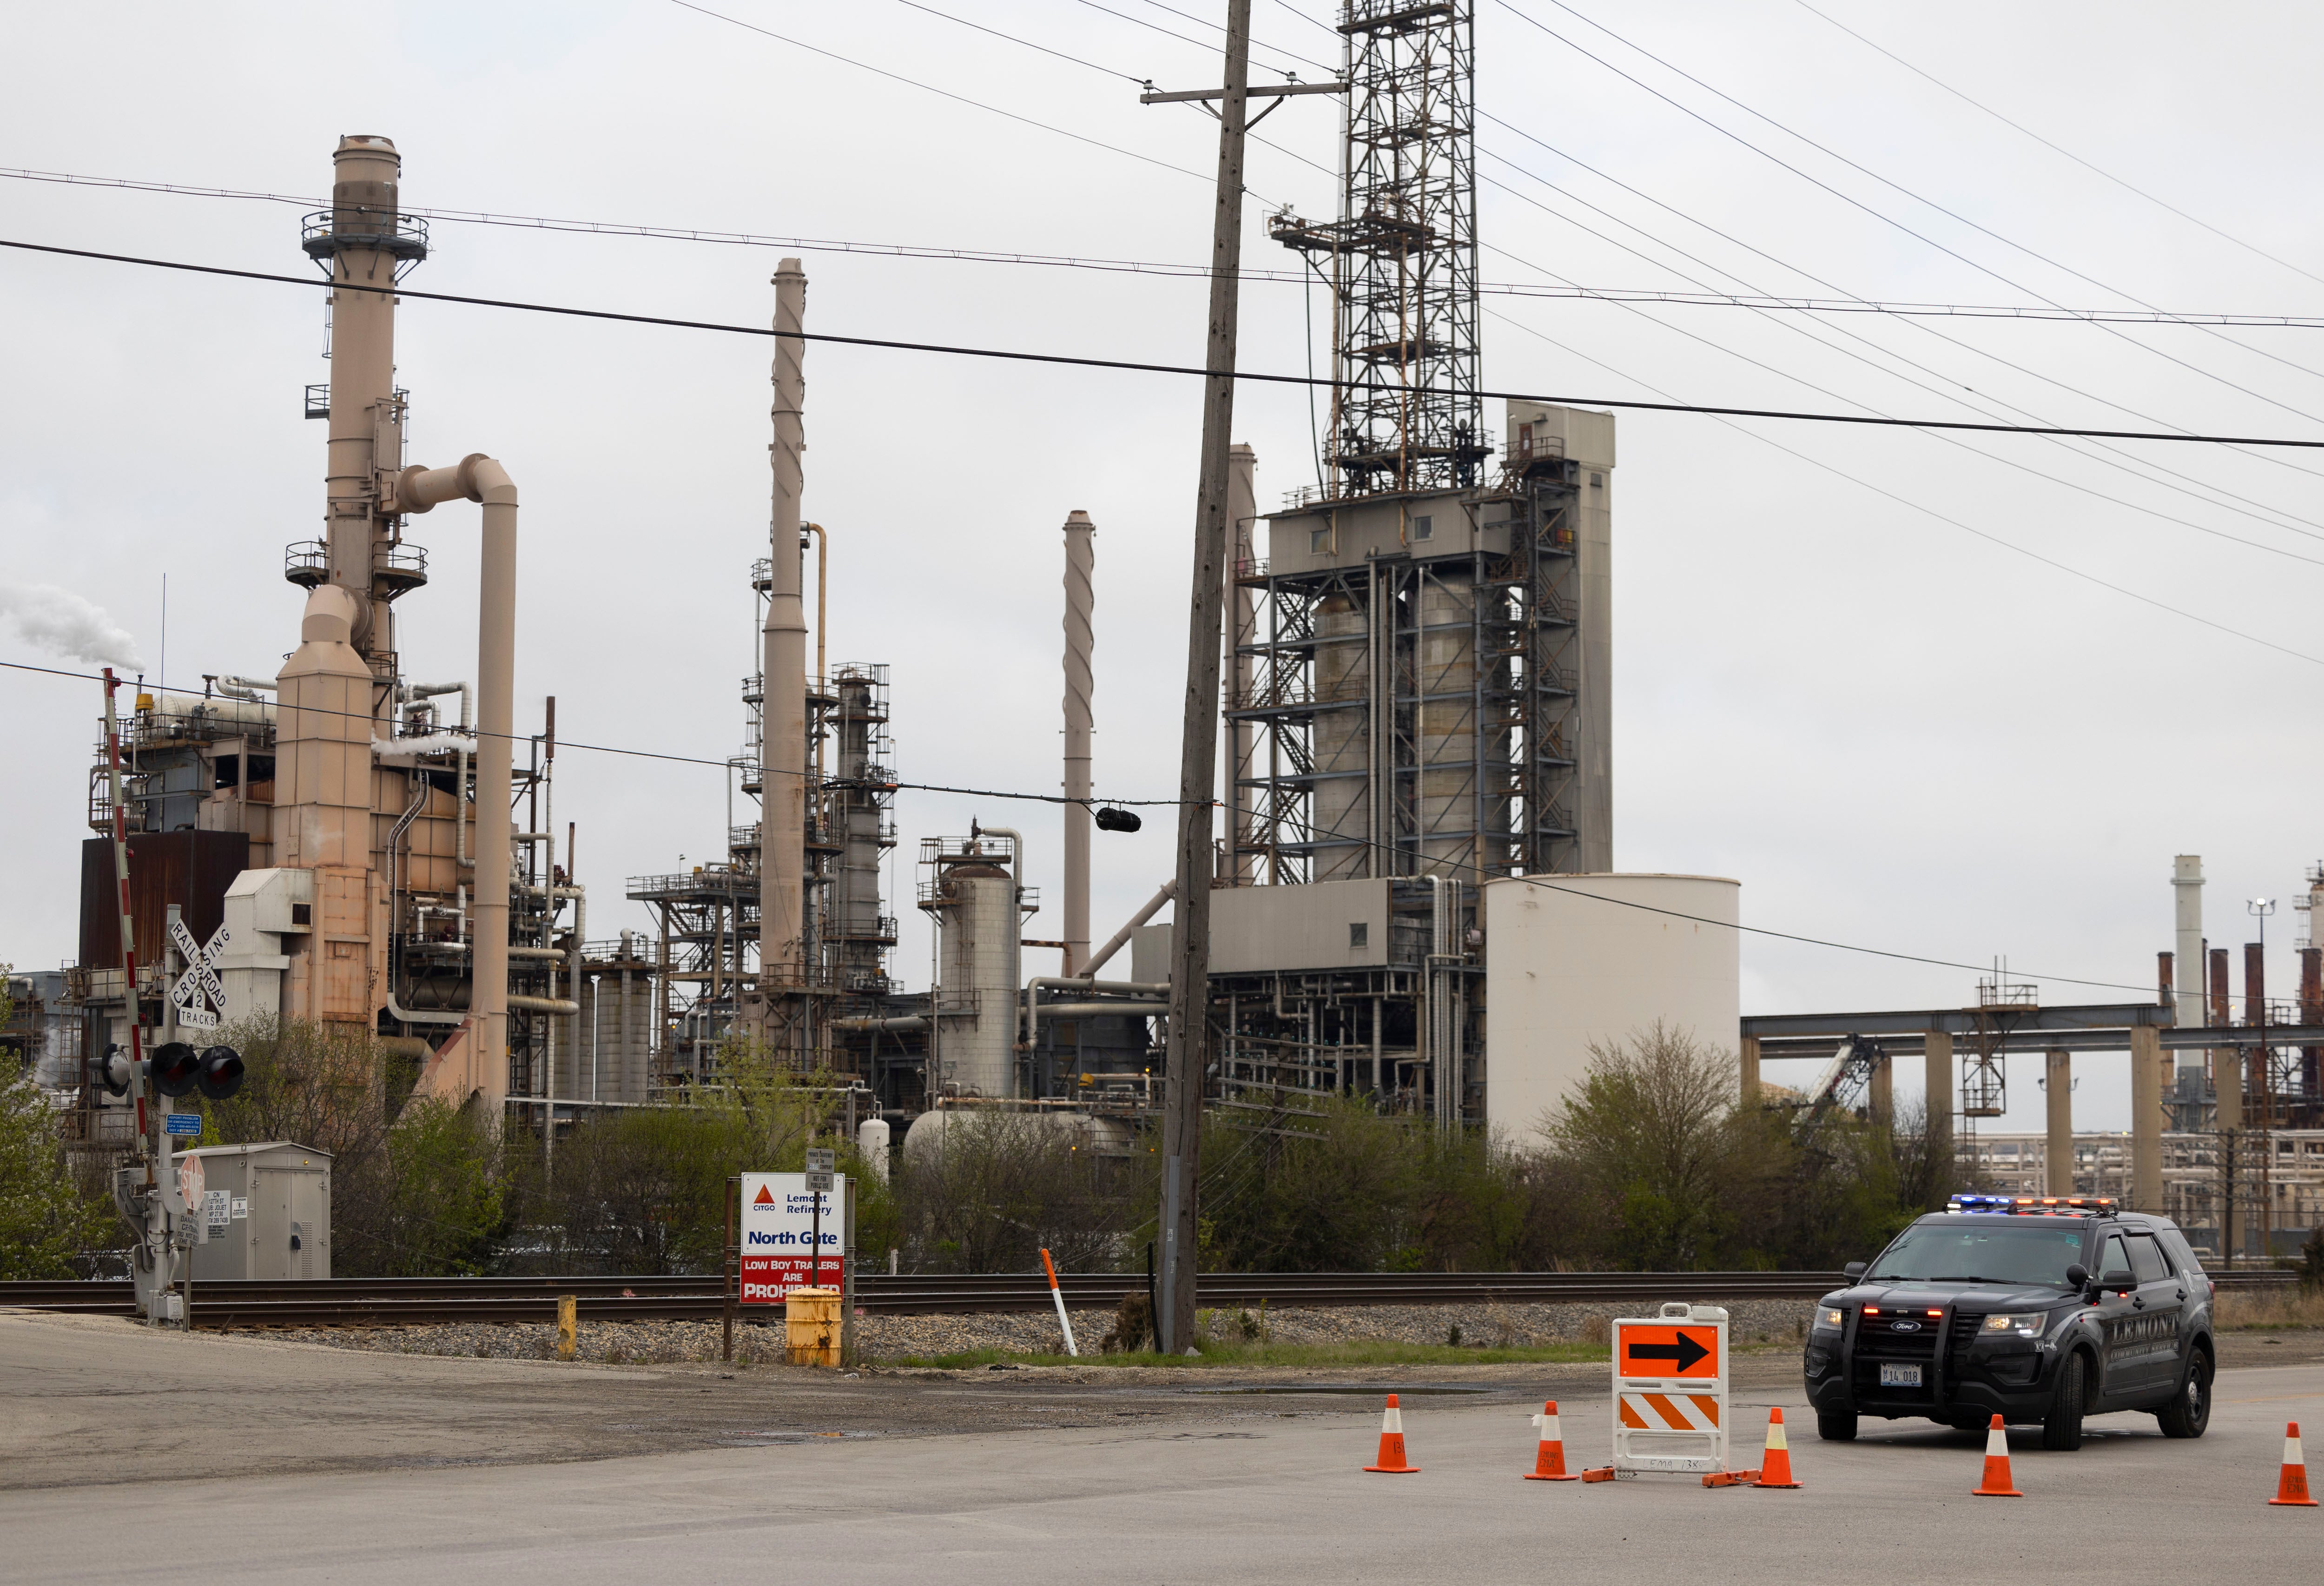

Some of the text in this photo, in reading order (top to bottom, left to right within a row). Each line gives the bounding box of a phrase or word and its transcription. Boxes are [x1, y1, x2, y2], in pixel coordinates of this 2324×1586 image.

[173, 923, 225, 1007] RAIL ROAD
[174, 929, 230, 1004] CROSSING
[196, 994, 202, 1008] 2
[182, 1011, 215, 1026] TRACKS
[183, 1170, 203, 1192] STOP
[748, 1231, 796, 1244] North
[745, 1261, 839, 1270] LOW BOY TRALERS
[782, 1273, 803, 1282] ARE
[2112, 1311, 2179, 1345] LEMONT
[2034, 1339, 2057, 1352] 17-4
[2111, 1343, 2151, 1362] COMMUNITY
[1889, 1371, 1917, 1381] 14 018
[1539, 1458, 1555, 1468] EMA
[1643, 1459, 1673, 1469] LEMA
[2287, 1483, 2304, 1493] EMA
